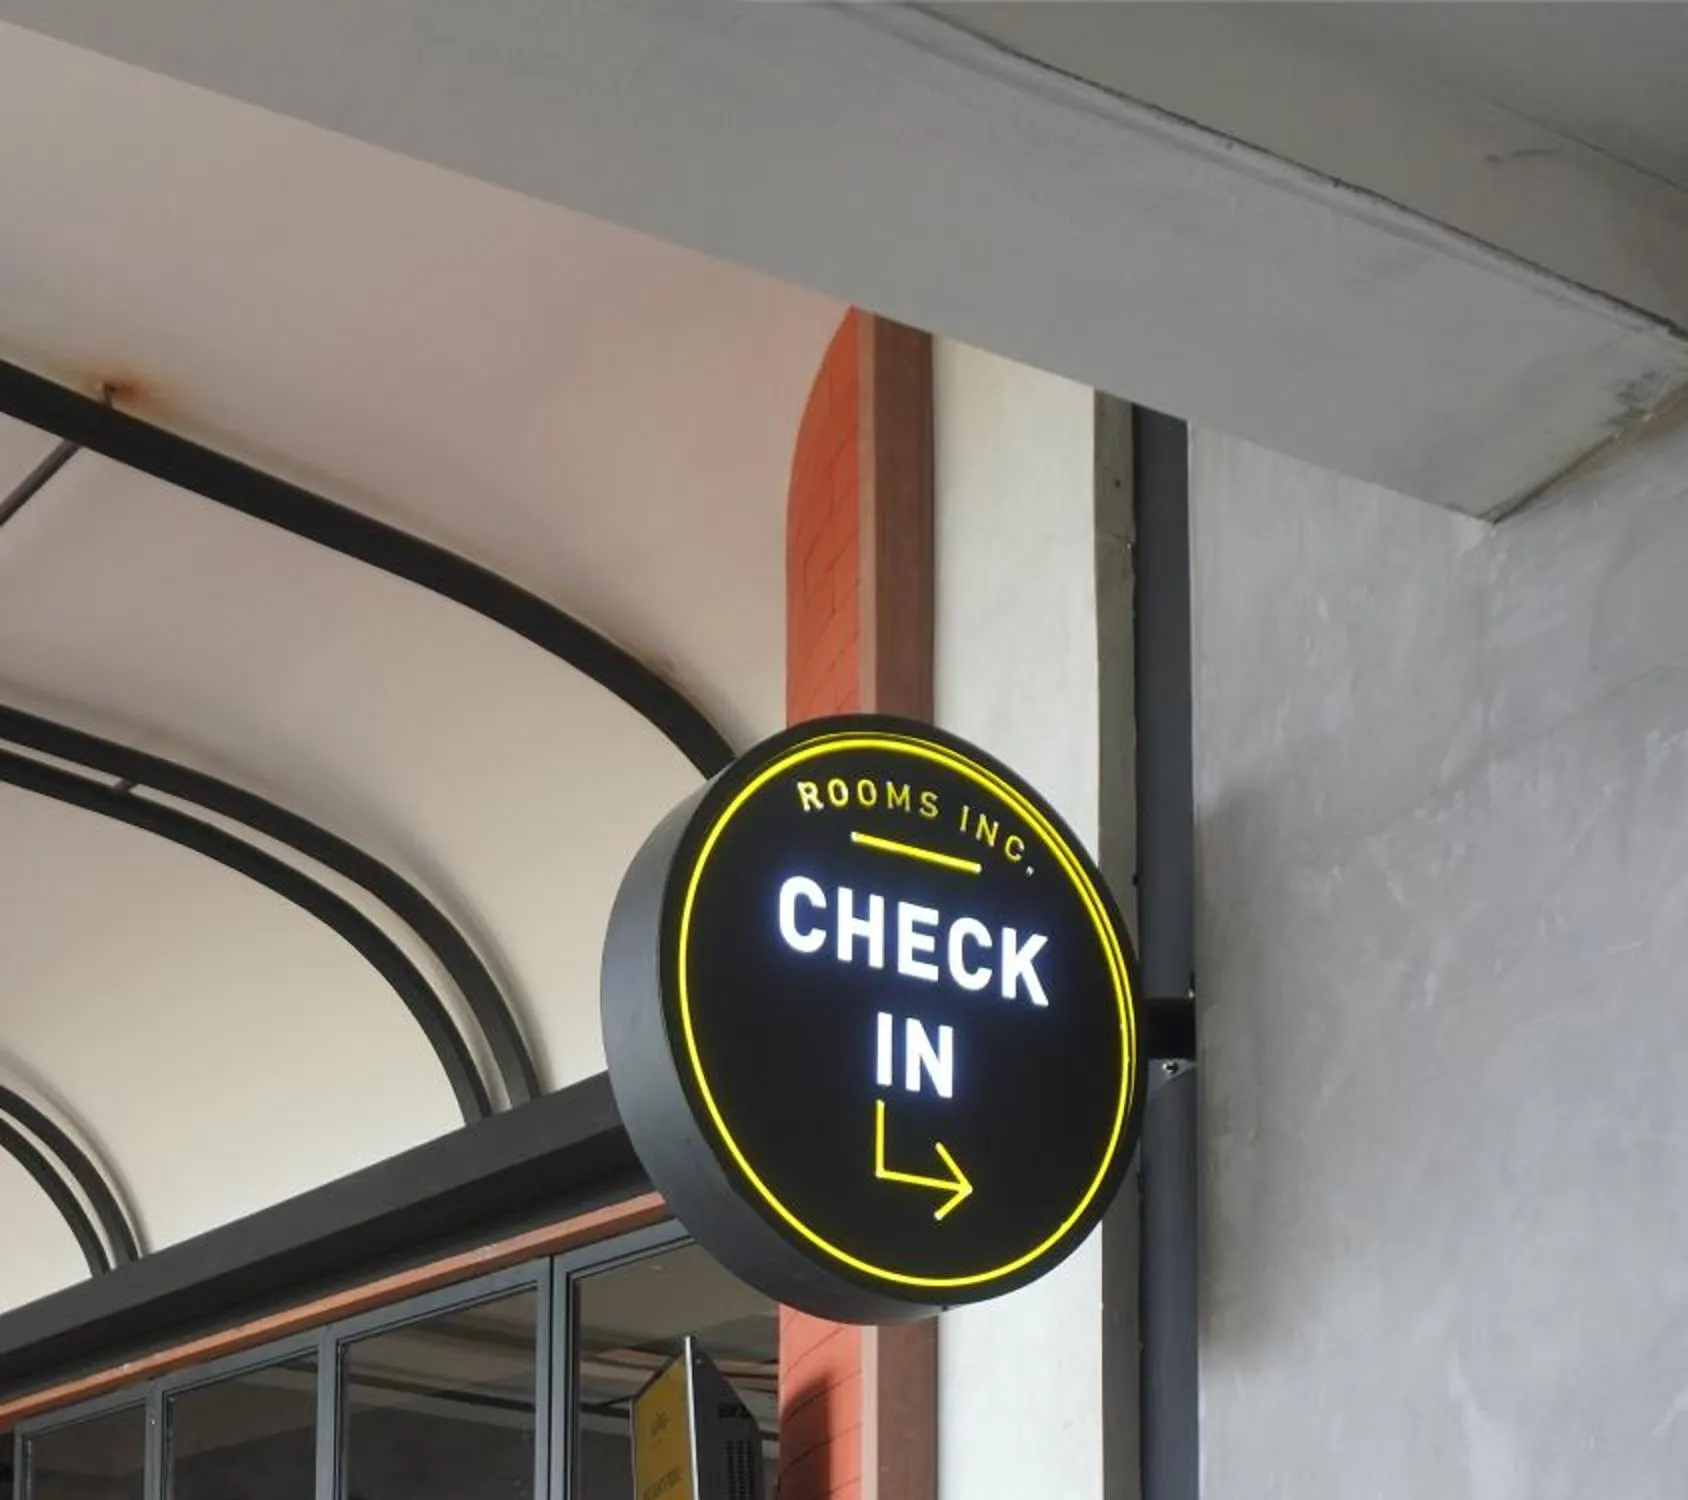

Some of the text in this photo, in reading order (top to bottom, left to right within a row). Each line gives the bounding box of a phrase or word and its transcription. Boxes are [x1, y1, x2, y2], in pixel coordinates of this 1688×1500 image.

[796, 778, 1035, 875] ROOMS INC.
[778, 875, 1049, 1008] CHECK
[876, 1011, 954, 1099] IN
